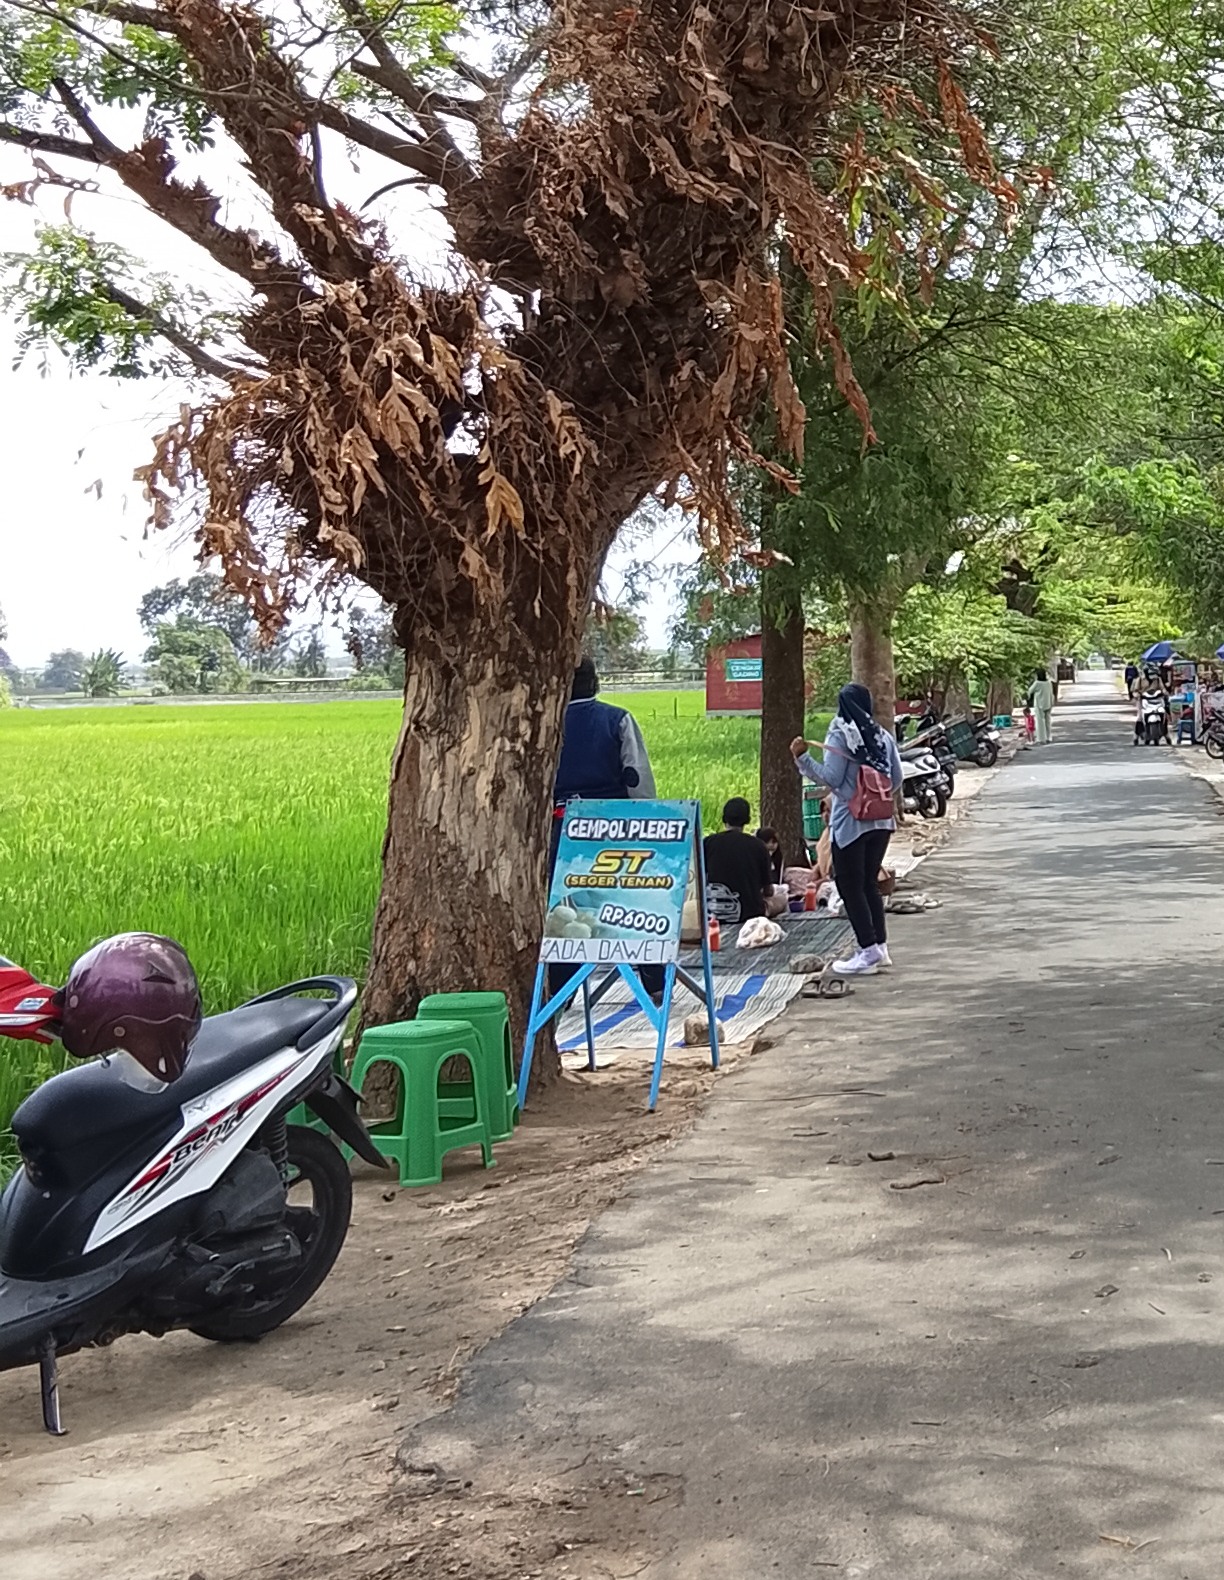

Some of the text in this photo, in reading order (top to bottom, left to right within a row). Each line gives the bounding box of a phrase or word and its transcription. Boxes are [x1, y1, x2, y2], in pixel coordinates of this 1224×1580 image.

[567, 818, 687, 840] GEMPOL PLERET
[591, 850, 653, 874] ST
[564, 875, 672, 888] (SEGER TENAN)
